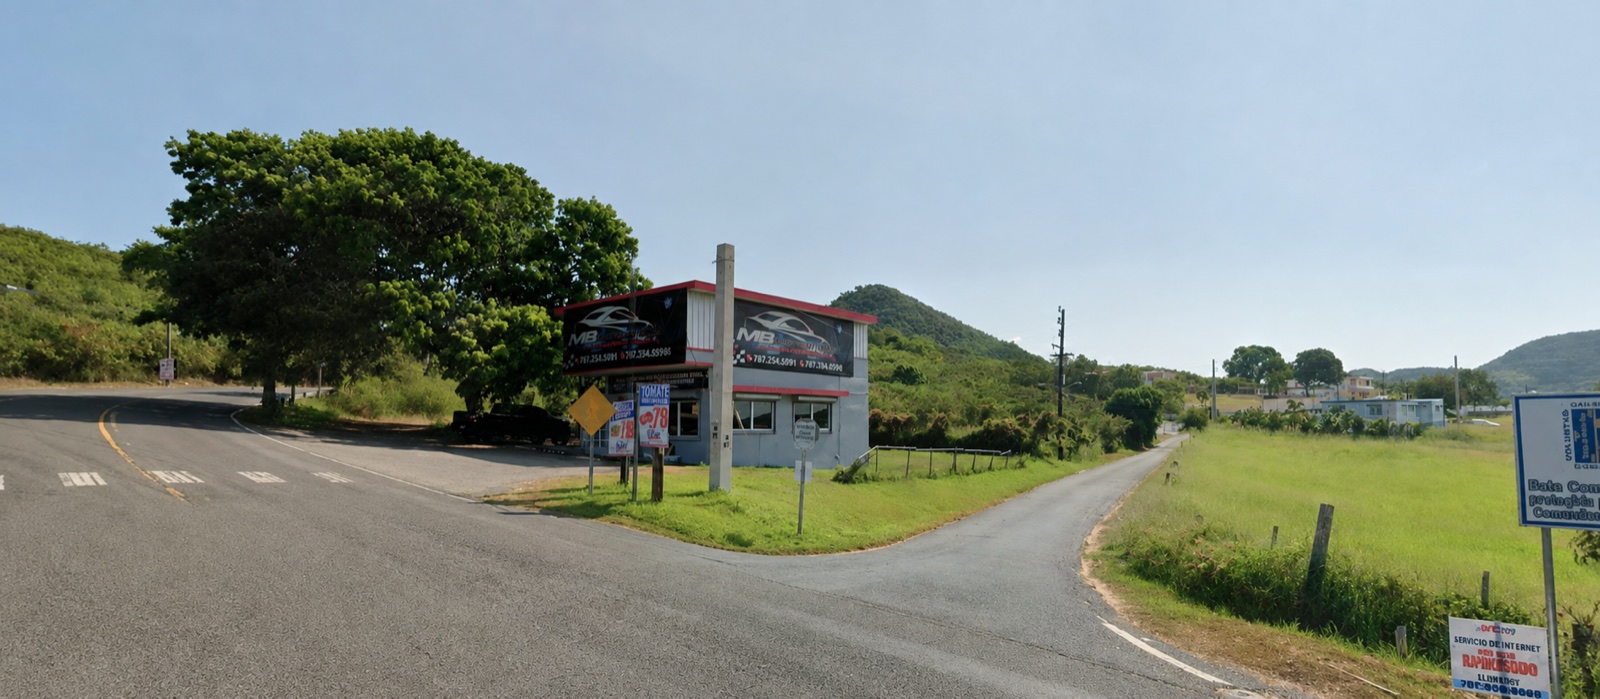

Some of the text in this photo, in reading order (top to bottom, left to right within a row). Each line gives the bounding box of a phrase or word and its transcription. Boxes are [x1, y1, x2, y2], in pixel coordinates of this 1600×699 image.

[568, 330, 598, 346] MB
[736, 327, 775, 344] MB
[641, 384, 669, 398] TOMATE
[1454, 636, 1541, 653] SERVICIO DE INTERNET
